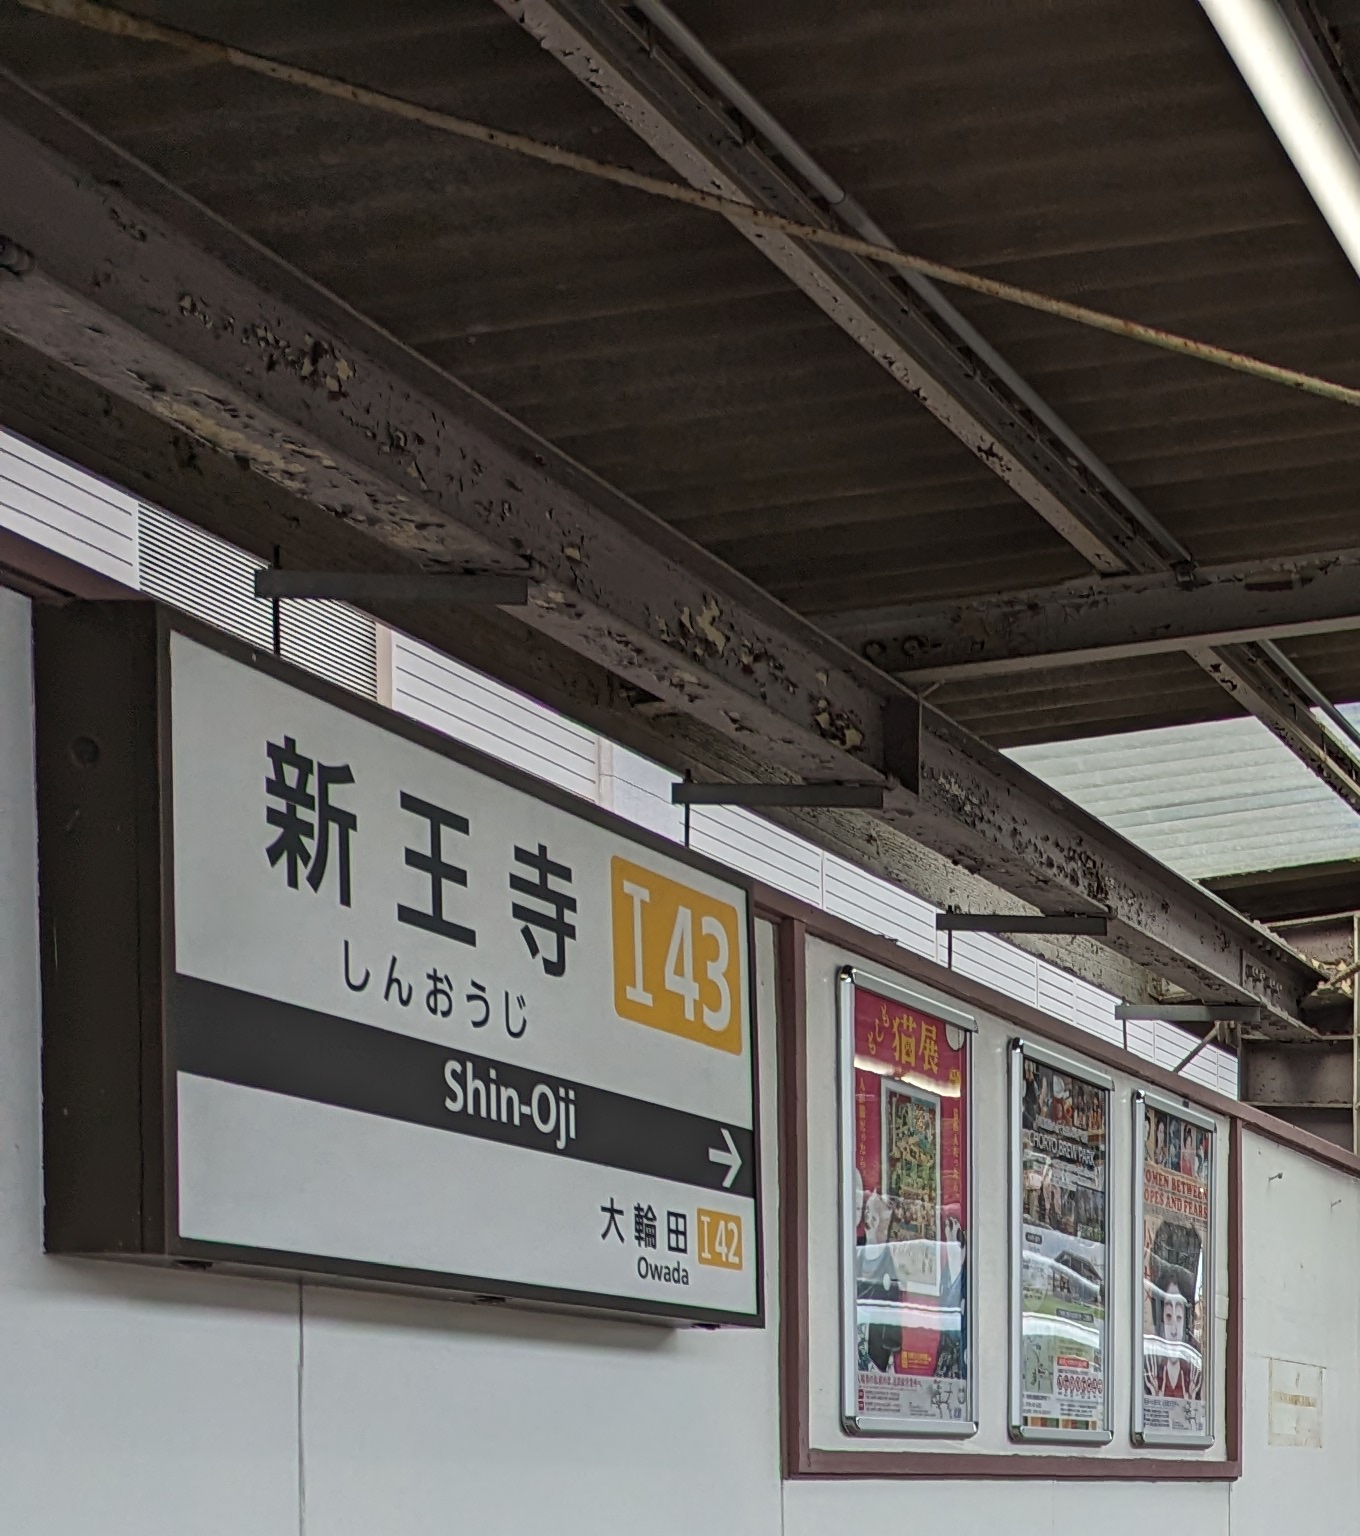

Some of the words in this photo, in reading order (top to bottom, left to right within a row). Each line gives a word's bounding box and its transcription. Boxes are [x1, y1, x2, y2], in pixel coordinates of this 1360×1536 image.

[265, 735, 580, 978] 新王寺
[343, 938, 529, 1040] しんおうじ
[892, 1014, 940, 1074] 猫展
[444, 1058, 577, 1149] Shin-Oji
[1143, 1187, 1164, 1206] OPES
[1165, 1194, 1183, 1211] AND
[1184, 1200, 1208, 1220] FEARS
[1144, 1168, 1169, 1189] OMEN
[600, 1197, 689, 1255] 大輪田
[636, 1256, 690, 1286] Owada
